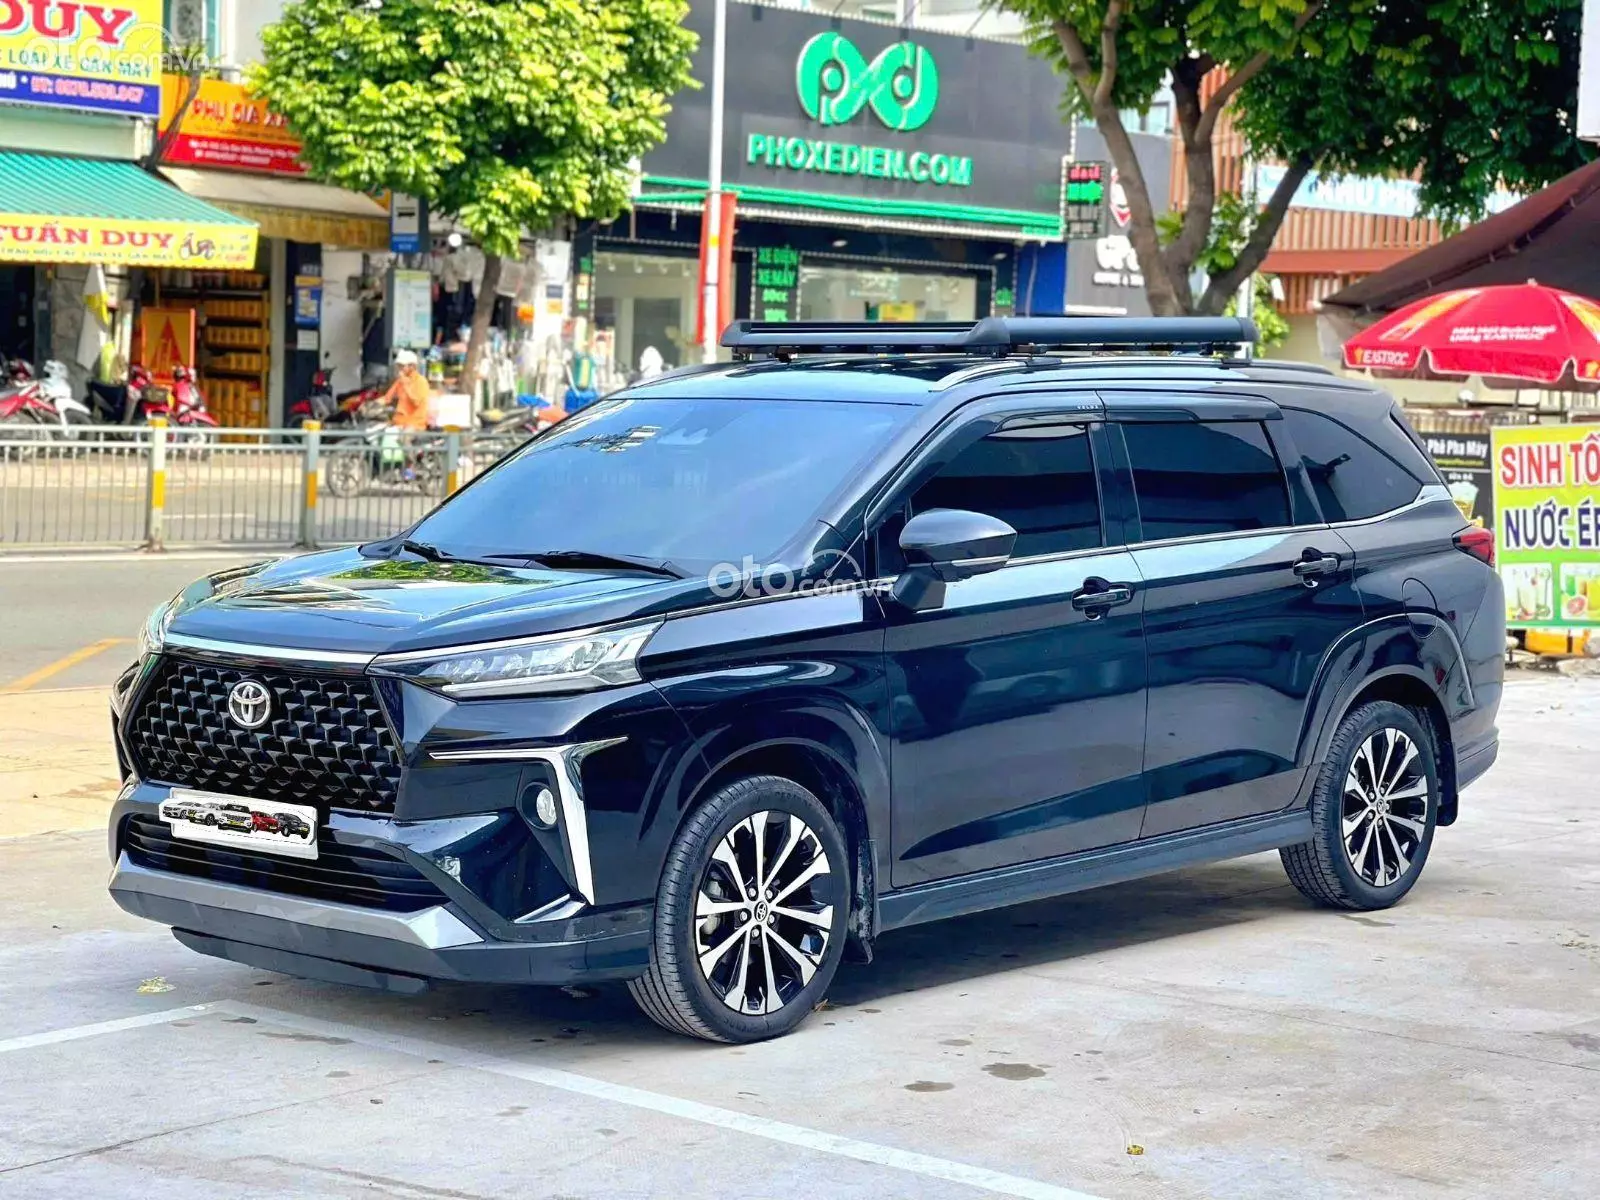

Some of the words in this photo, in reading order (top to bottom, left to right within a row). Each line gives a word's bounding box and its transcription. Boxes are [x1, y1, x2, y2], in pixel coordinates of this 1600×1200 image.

[747, 133, 972, 187] PHOXEDIEN.COM
[101, 230, 174, 248] DUY
[1501, 443, 1563, 486] SINH
[1504, 498, 1570, 548] NƯỚC
